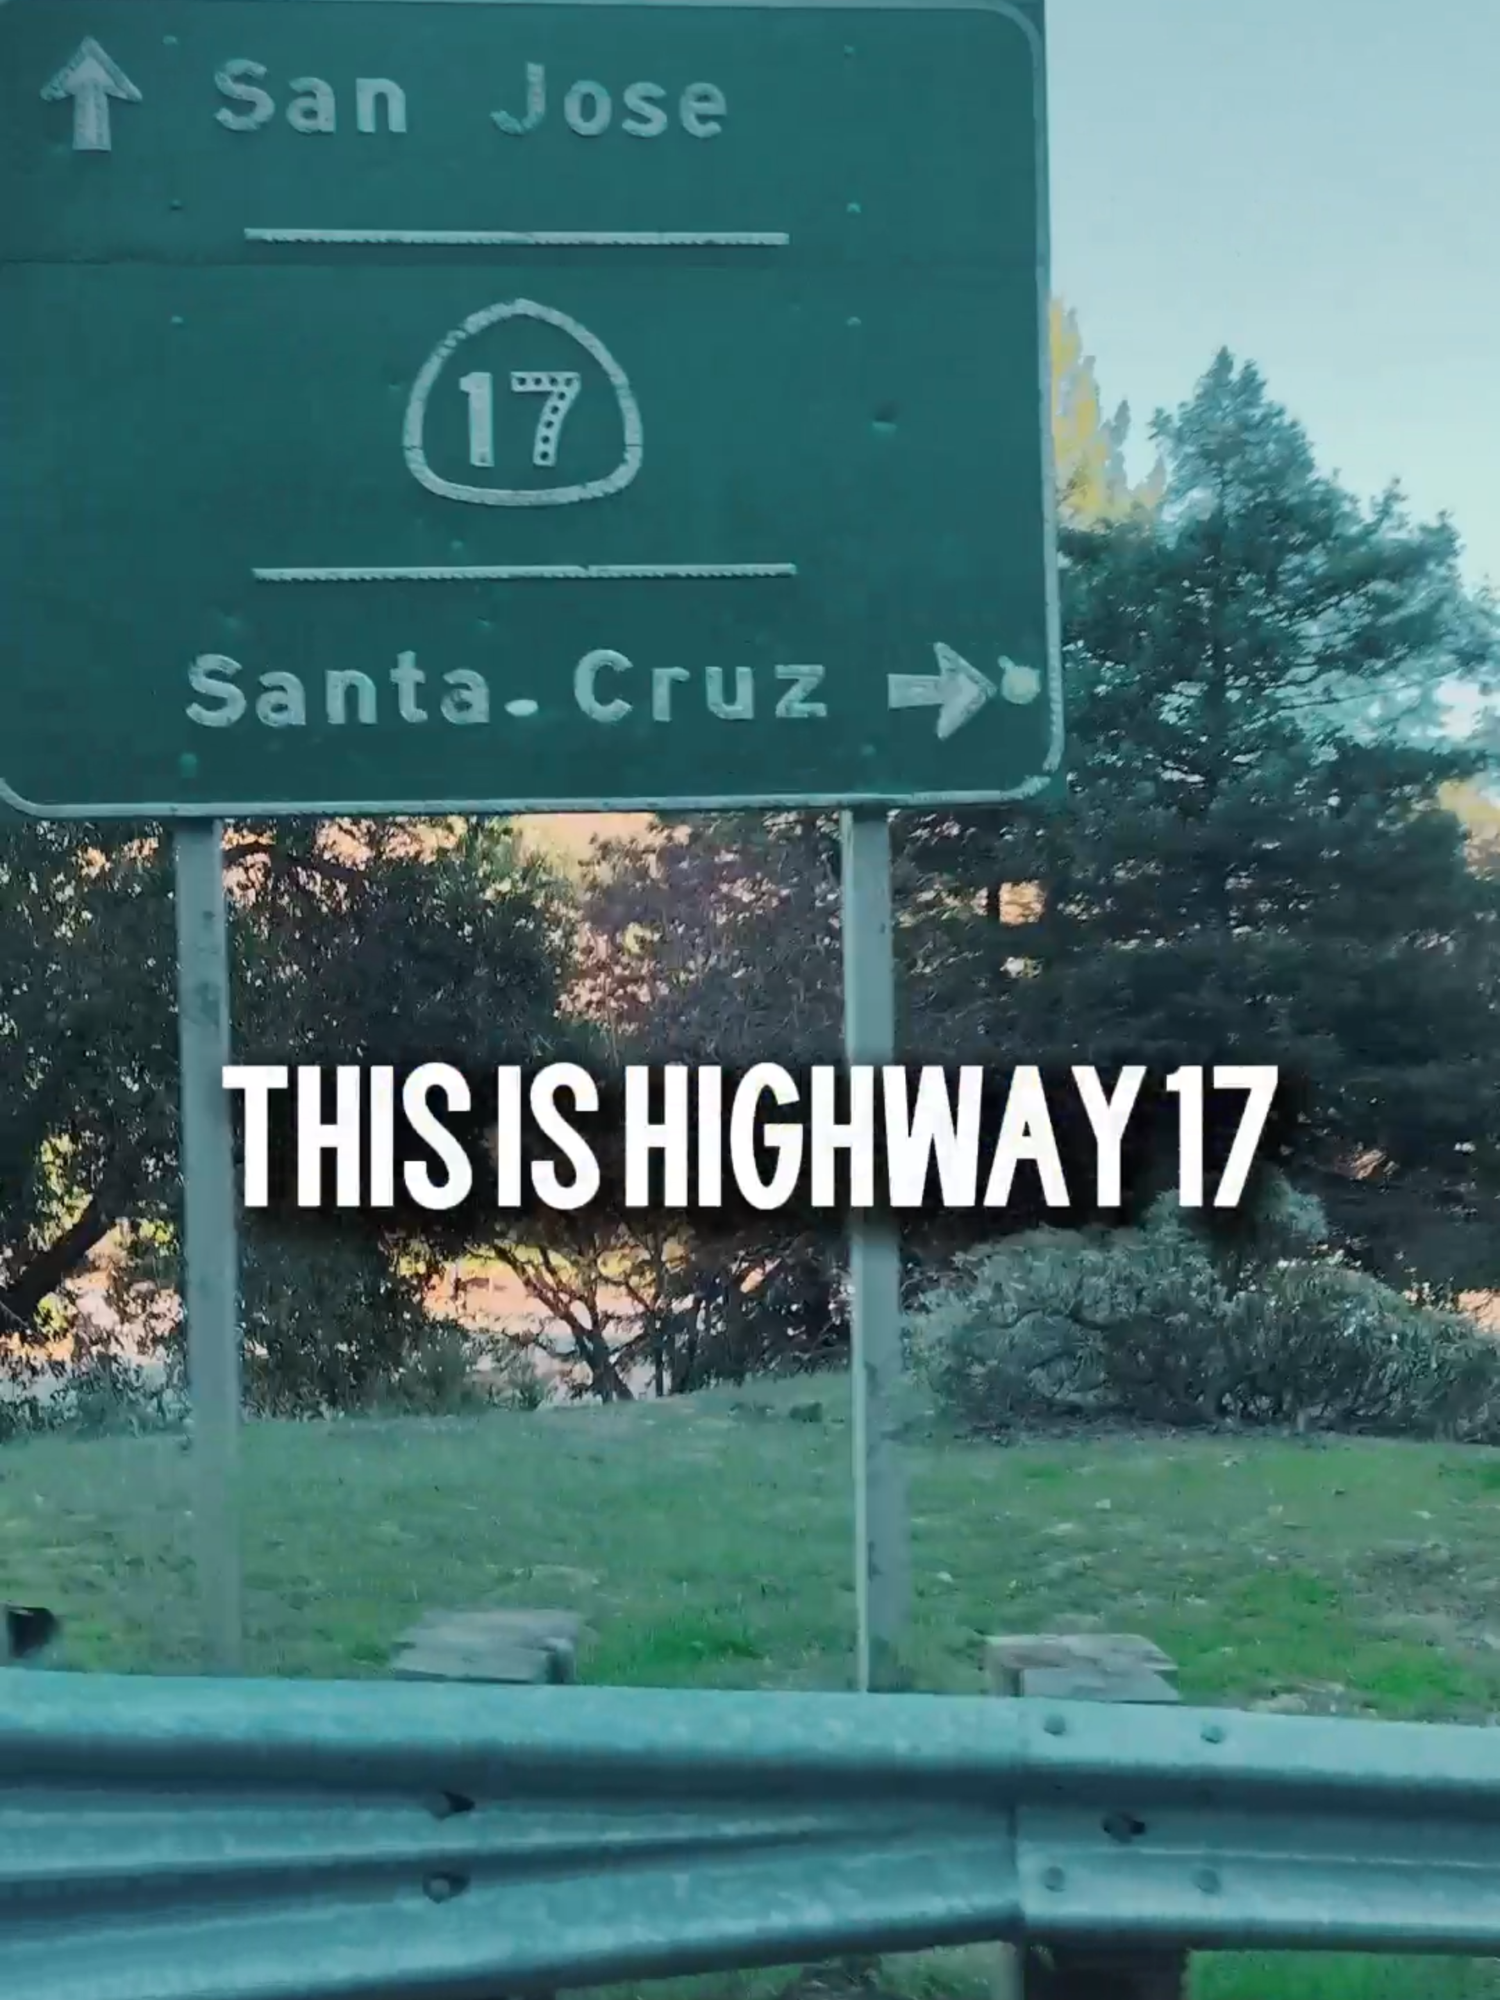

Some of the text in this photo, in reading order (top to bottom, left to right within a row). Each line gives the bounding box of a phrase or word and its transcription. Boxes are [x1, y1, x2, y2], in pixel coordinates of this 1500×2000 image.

[213, 57, 729, 139] San Jose
[458, 371, 581, 468] 17
[186, 649, 828, 729] Santa Cruz
